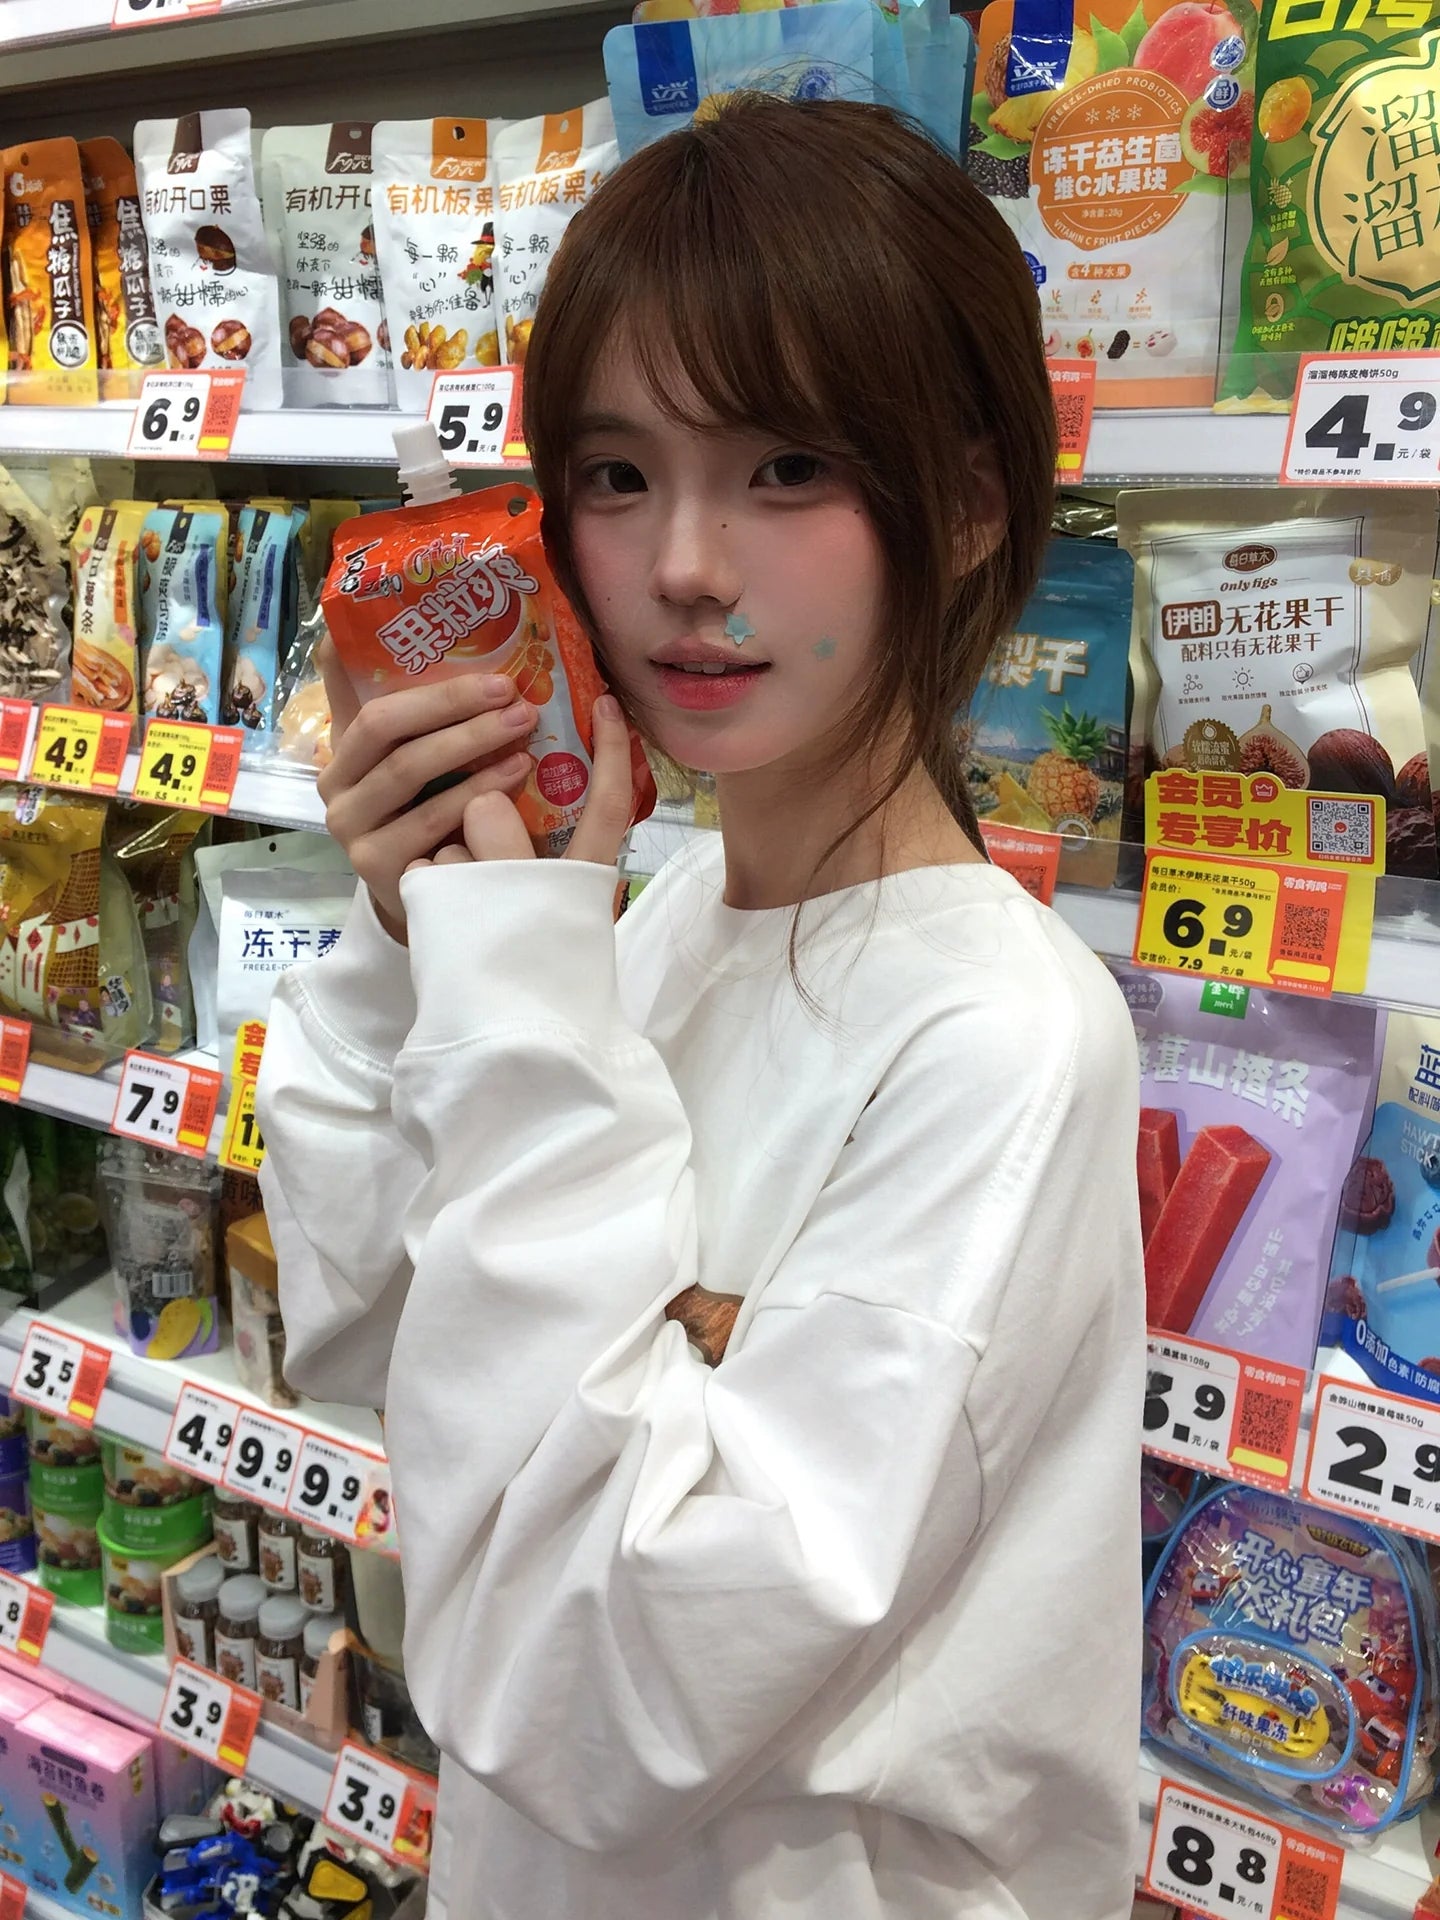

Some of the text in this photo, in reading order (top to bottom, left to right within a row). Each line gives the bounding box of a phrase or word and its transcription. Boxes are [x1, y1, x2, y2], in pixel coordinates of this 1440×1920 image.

[1046, 76, 1182, 130] FREEZE-DRIED PROBIOTICS
[1043, 133, 1181, 174] 冻干益生菌
[144, 184, 232, 215] 有机开口栗
[1054, 167, 1168, 201] 维C水果块
[297, 231, 339, 252] 坚强的
[1053, 210, 1162, 246] VITAMIN C FRUIT PIECES
[48, 201, 76, 319] 焦糖瓜子
[404, 238, 459, 265] 每一颗
[1307, 369, 1399, 380] 溜溜梅陈皮梅饼50g
[142, 397, 200, 441] 6.9
[438, 402, 503, 452] 5.9
[1305, 391, 1437, 461] 4.9
[1397, 447, 1431, 459] 元/袋
[1220, 576, 1278, 592] Only figs
[377, 543, 539, 675] 果粒爽
[1165, 596, 1344, 636] 伊朗 无花果干
[1181, 632, 1322, 663] 配料只有无花果干
[45, 737, 88, 772] 4.9
[150, 753, 196, 790] 4.9
[1157, 773, 1244, 809] 会员
[1157, 812, 1292, 853] 专享价
[1150, 882, 1181, 893] 会员价:
[1151, 866, 1256, 888] 每日草木伊朗无花果干50g
[1163, 899, 1253, 956] 6.9
[1178, 956, 1203, 970] 7.9
[1229, 949, 1252, 960] 元/袋
[125, 1082, 179, 1131] 7.9
[24, 1350, 74, 1396] 3.5
[1329, 1393, 1424, 1428] 金晔山楂棒蓝莓味50g
[177, 1414, 232, 1463] 4.9
[235, 1437, 293, 1488] 9.9
[1328, 1425, 1440, 1506] 2.9
[300, 1463, 360, 1517] 9.9
[1233, 1530, 1374, 1614] 开心童年
[1233, 1575, 1347, 1646] 大礼包
[171, 1686, 222, 1738] 3.9
[1222, 1702, 1290, 1742] 纤味果冻
[338, 1775, 395, 1834] 3.9
[1166, 1825, 1267, 1903] 8.8
